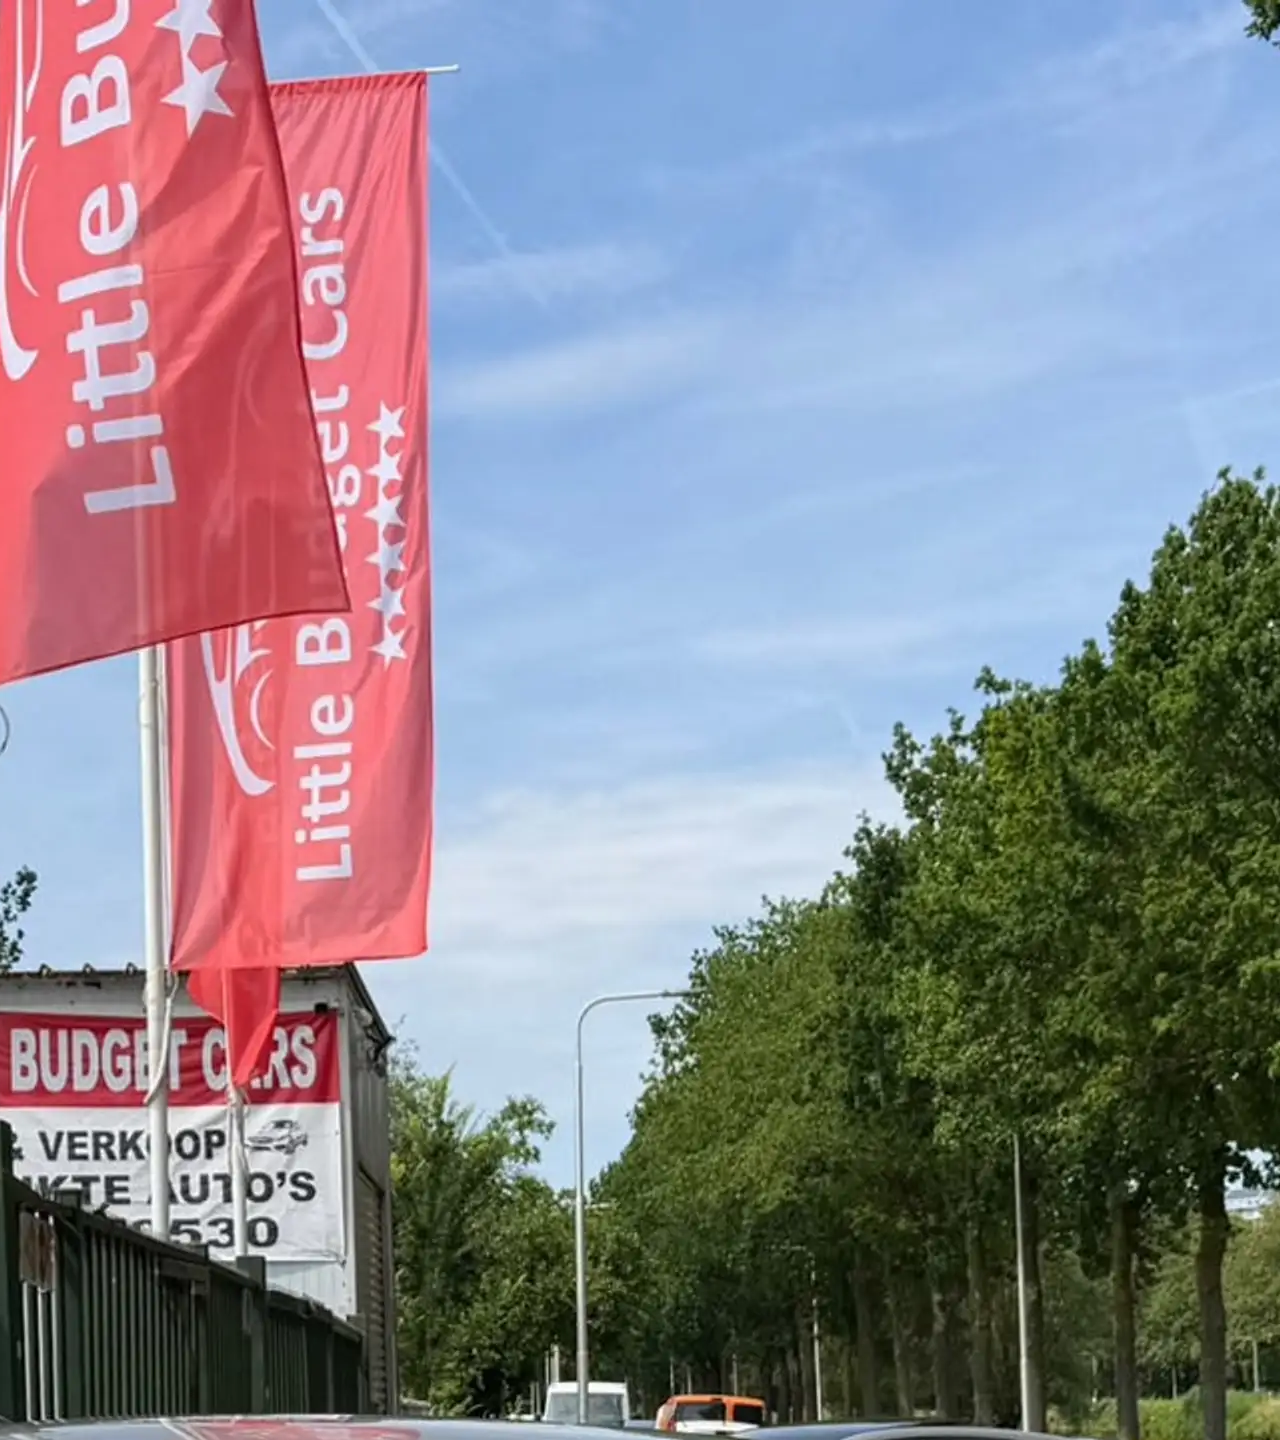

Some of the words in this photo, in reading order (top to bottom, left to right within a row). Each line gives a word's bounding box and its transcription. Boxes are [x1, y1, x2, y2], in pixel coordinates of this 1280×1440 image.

[58, 181, 176, 515] Little
[299, 187, 348, 361] Cars
[293, 693, 354, 882] Little
[202, 1024, 317, 1092] CRS
[38, 1129, 225, 1162] VERKOP
